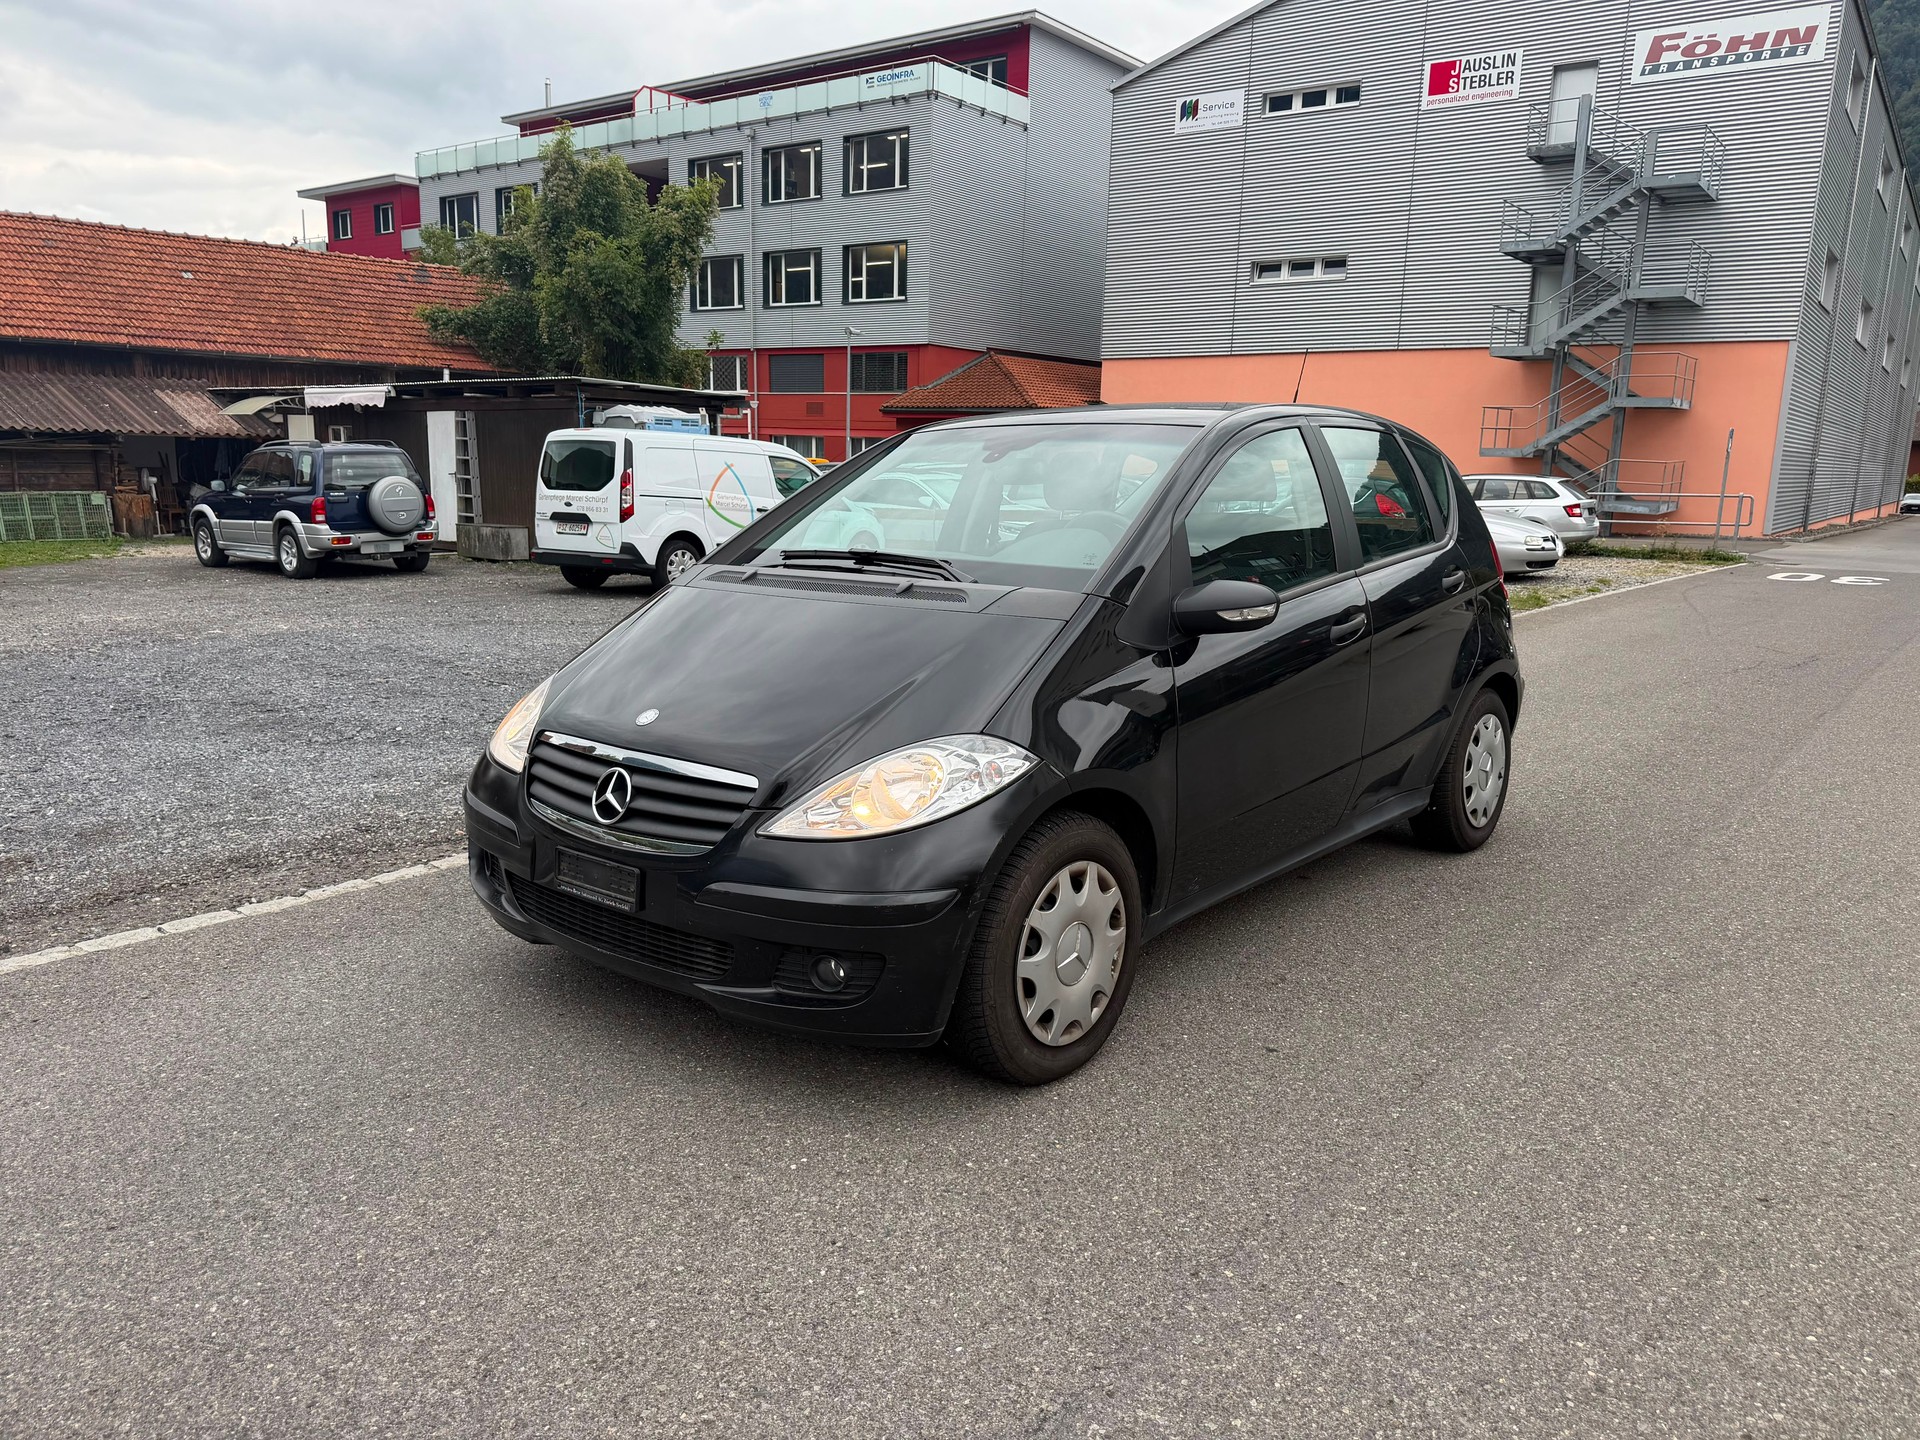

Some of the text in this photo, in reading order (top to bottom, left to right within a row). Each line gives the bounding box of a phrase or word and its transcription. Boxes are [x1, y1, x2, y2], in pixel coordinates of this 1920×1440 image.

[1644, 25, 1819, 64] FÖHN
[1643, 45, 1806, 75] TRANSPORTE
[877, 69, 914, 83] GEOINFRA
[1448, 71, 1515, 93] STEBLER
[1426, 89, 1513, 107] personalized engineering
[566, 494, 583, 502] Marcel
[585, 495, 608, 504] Schürpf
